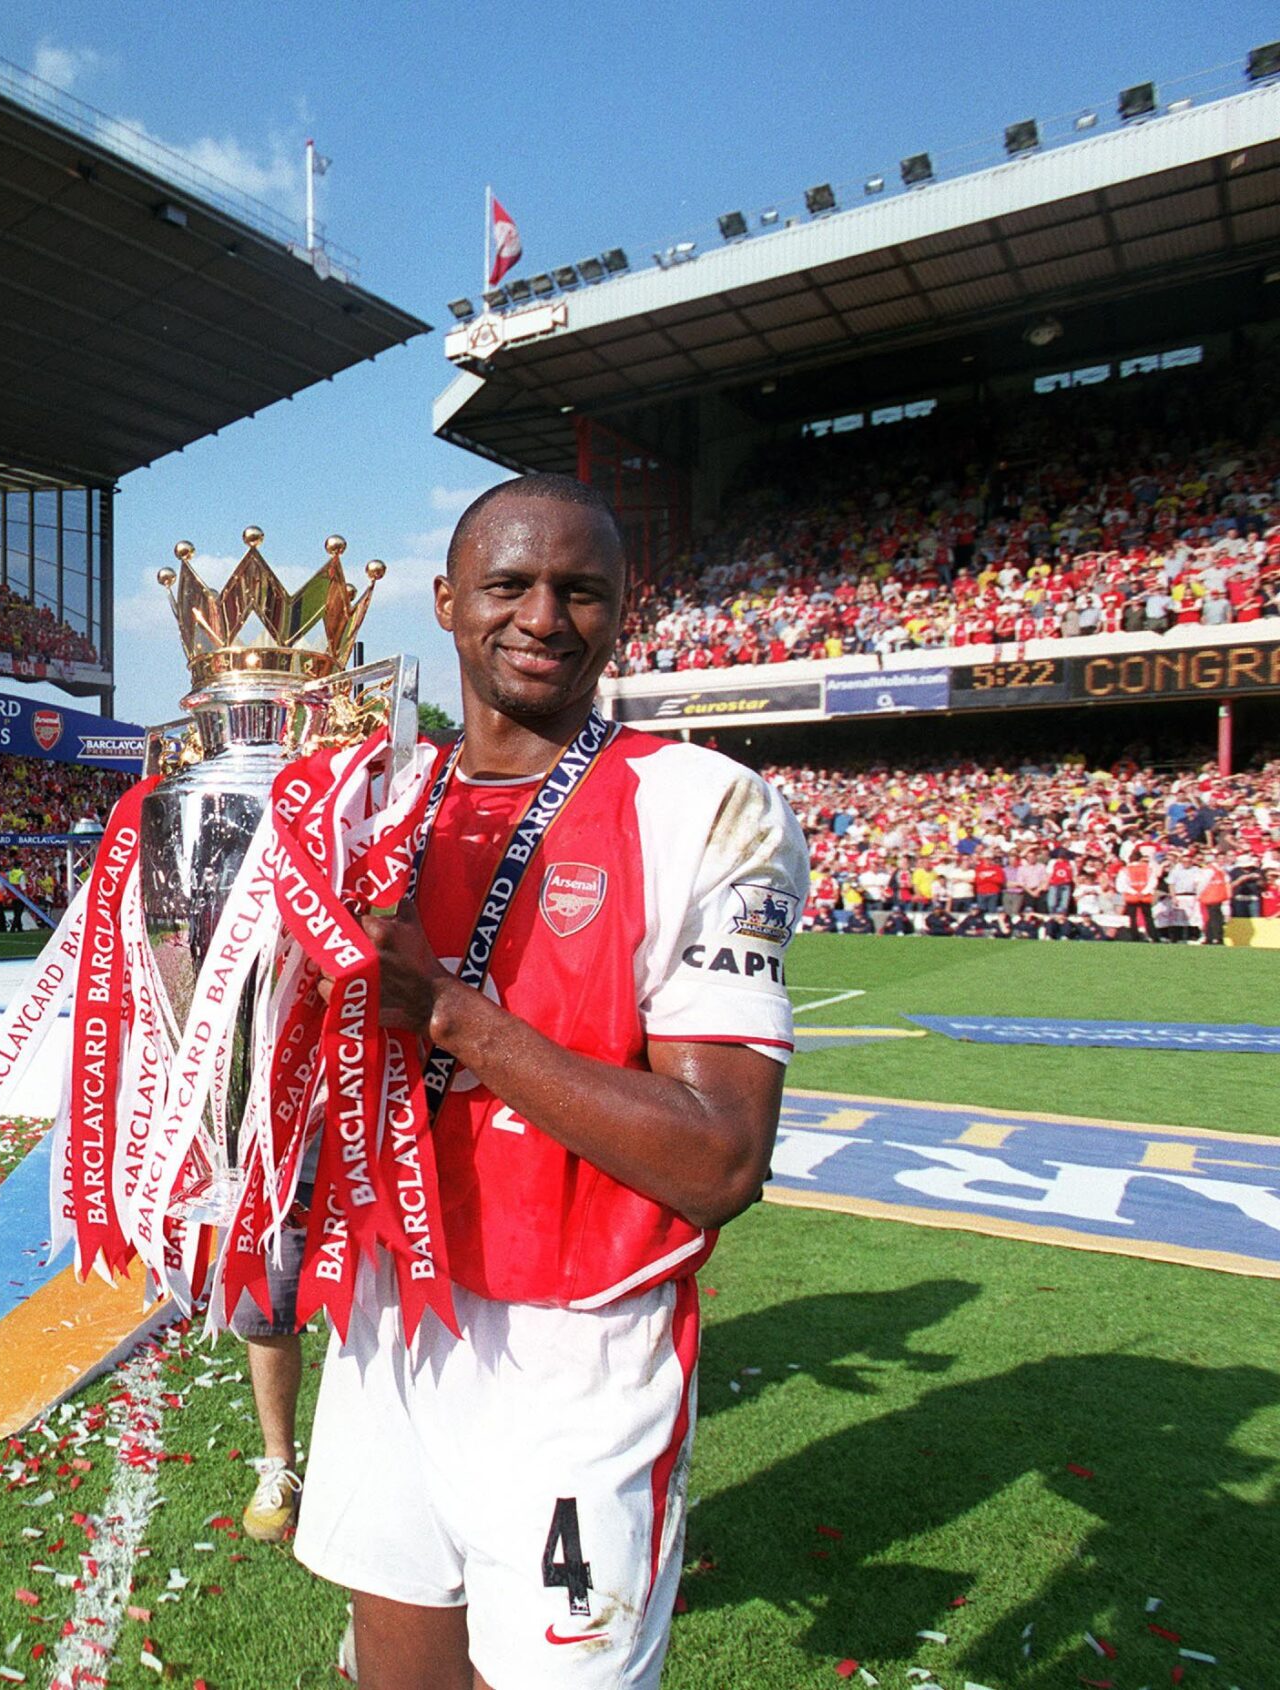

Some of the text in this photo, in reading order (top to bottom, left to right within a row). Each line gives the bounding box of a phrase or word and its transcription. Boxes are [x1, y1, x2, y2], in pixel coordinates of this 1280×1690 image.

[684, 697, 769, 715] eurostar
[972, 647, 1280, 697] 5:22 CONGR
[89, 826, 139, 1004] BARCLAYCARD
[551, 875, 597, 891] Arsenal
[84, 1017, 109, 1226] BARCLAYCARD
[339, 978, 377, 1207] BARCLAYCARD
[387, 1036, 437, 1281] BARCLAYCARD
[542, 1497, 593, 1616] 4
